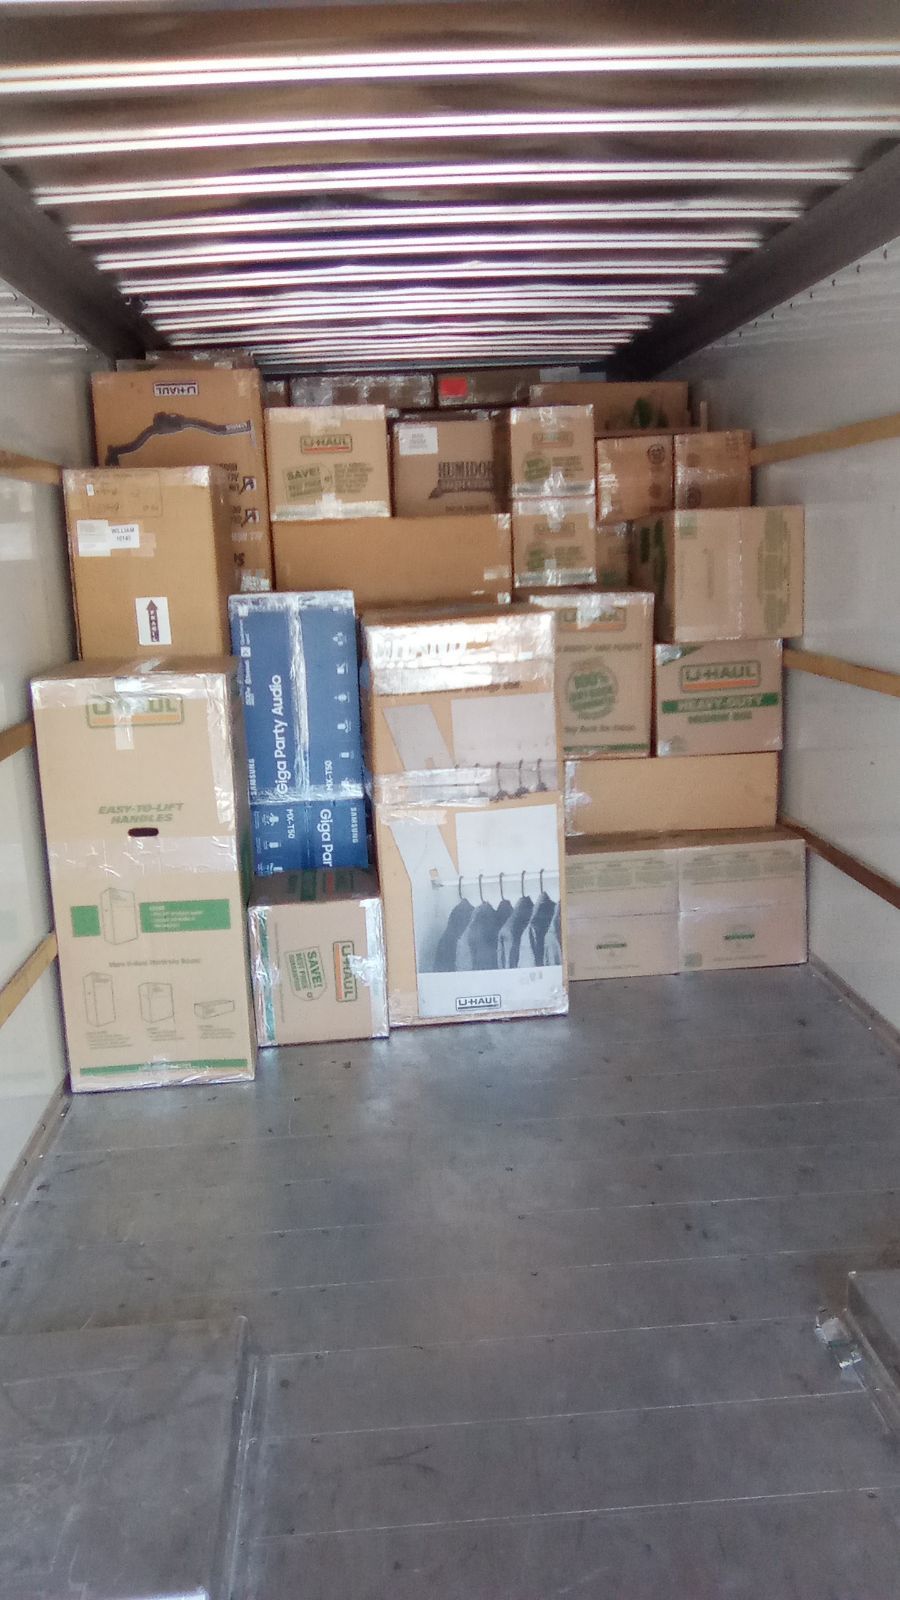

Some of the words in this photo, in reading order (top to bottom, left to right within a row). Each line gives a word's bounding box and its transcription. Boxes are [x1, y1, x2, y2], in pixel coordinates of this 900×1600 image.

[155, 385, 197, 395] U-HAUL
[303, 437, 348, 447] U-HAUL
[685, 666, 757, 681] U-HAUL
[269, 674, 284, 716] Audio
[272, 719, 288, 758] Party
[248, 758, 257, 796] SAMSUNG
[275, 760, 291, 794] Giga
[324, 760, 333, 791] MX-T50
[98, 802, 184, 815] EASY-TO-LIFT
[110, 813, 174, 824] HANDLES
[286, 808, 295, 839] MX-T50
[317, 808, 333, 842] Giga
[350, 807, 359, 844] SAMSUNG
[307, 950, 323, 988] SAVE!
[458, 997, 498, 1006] U-HAUL
